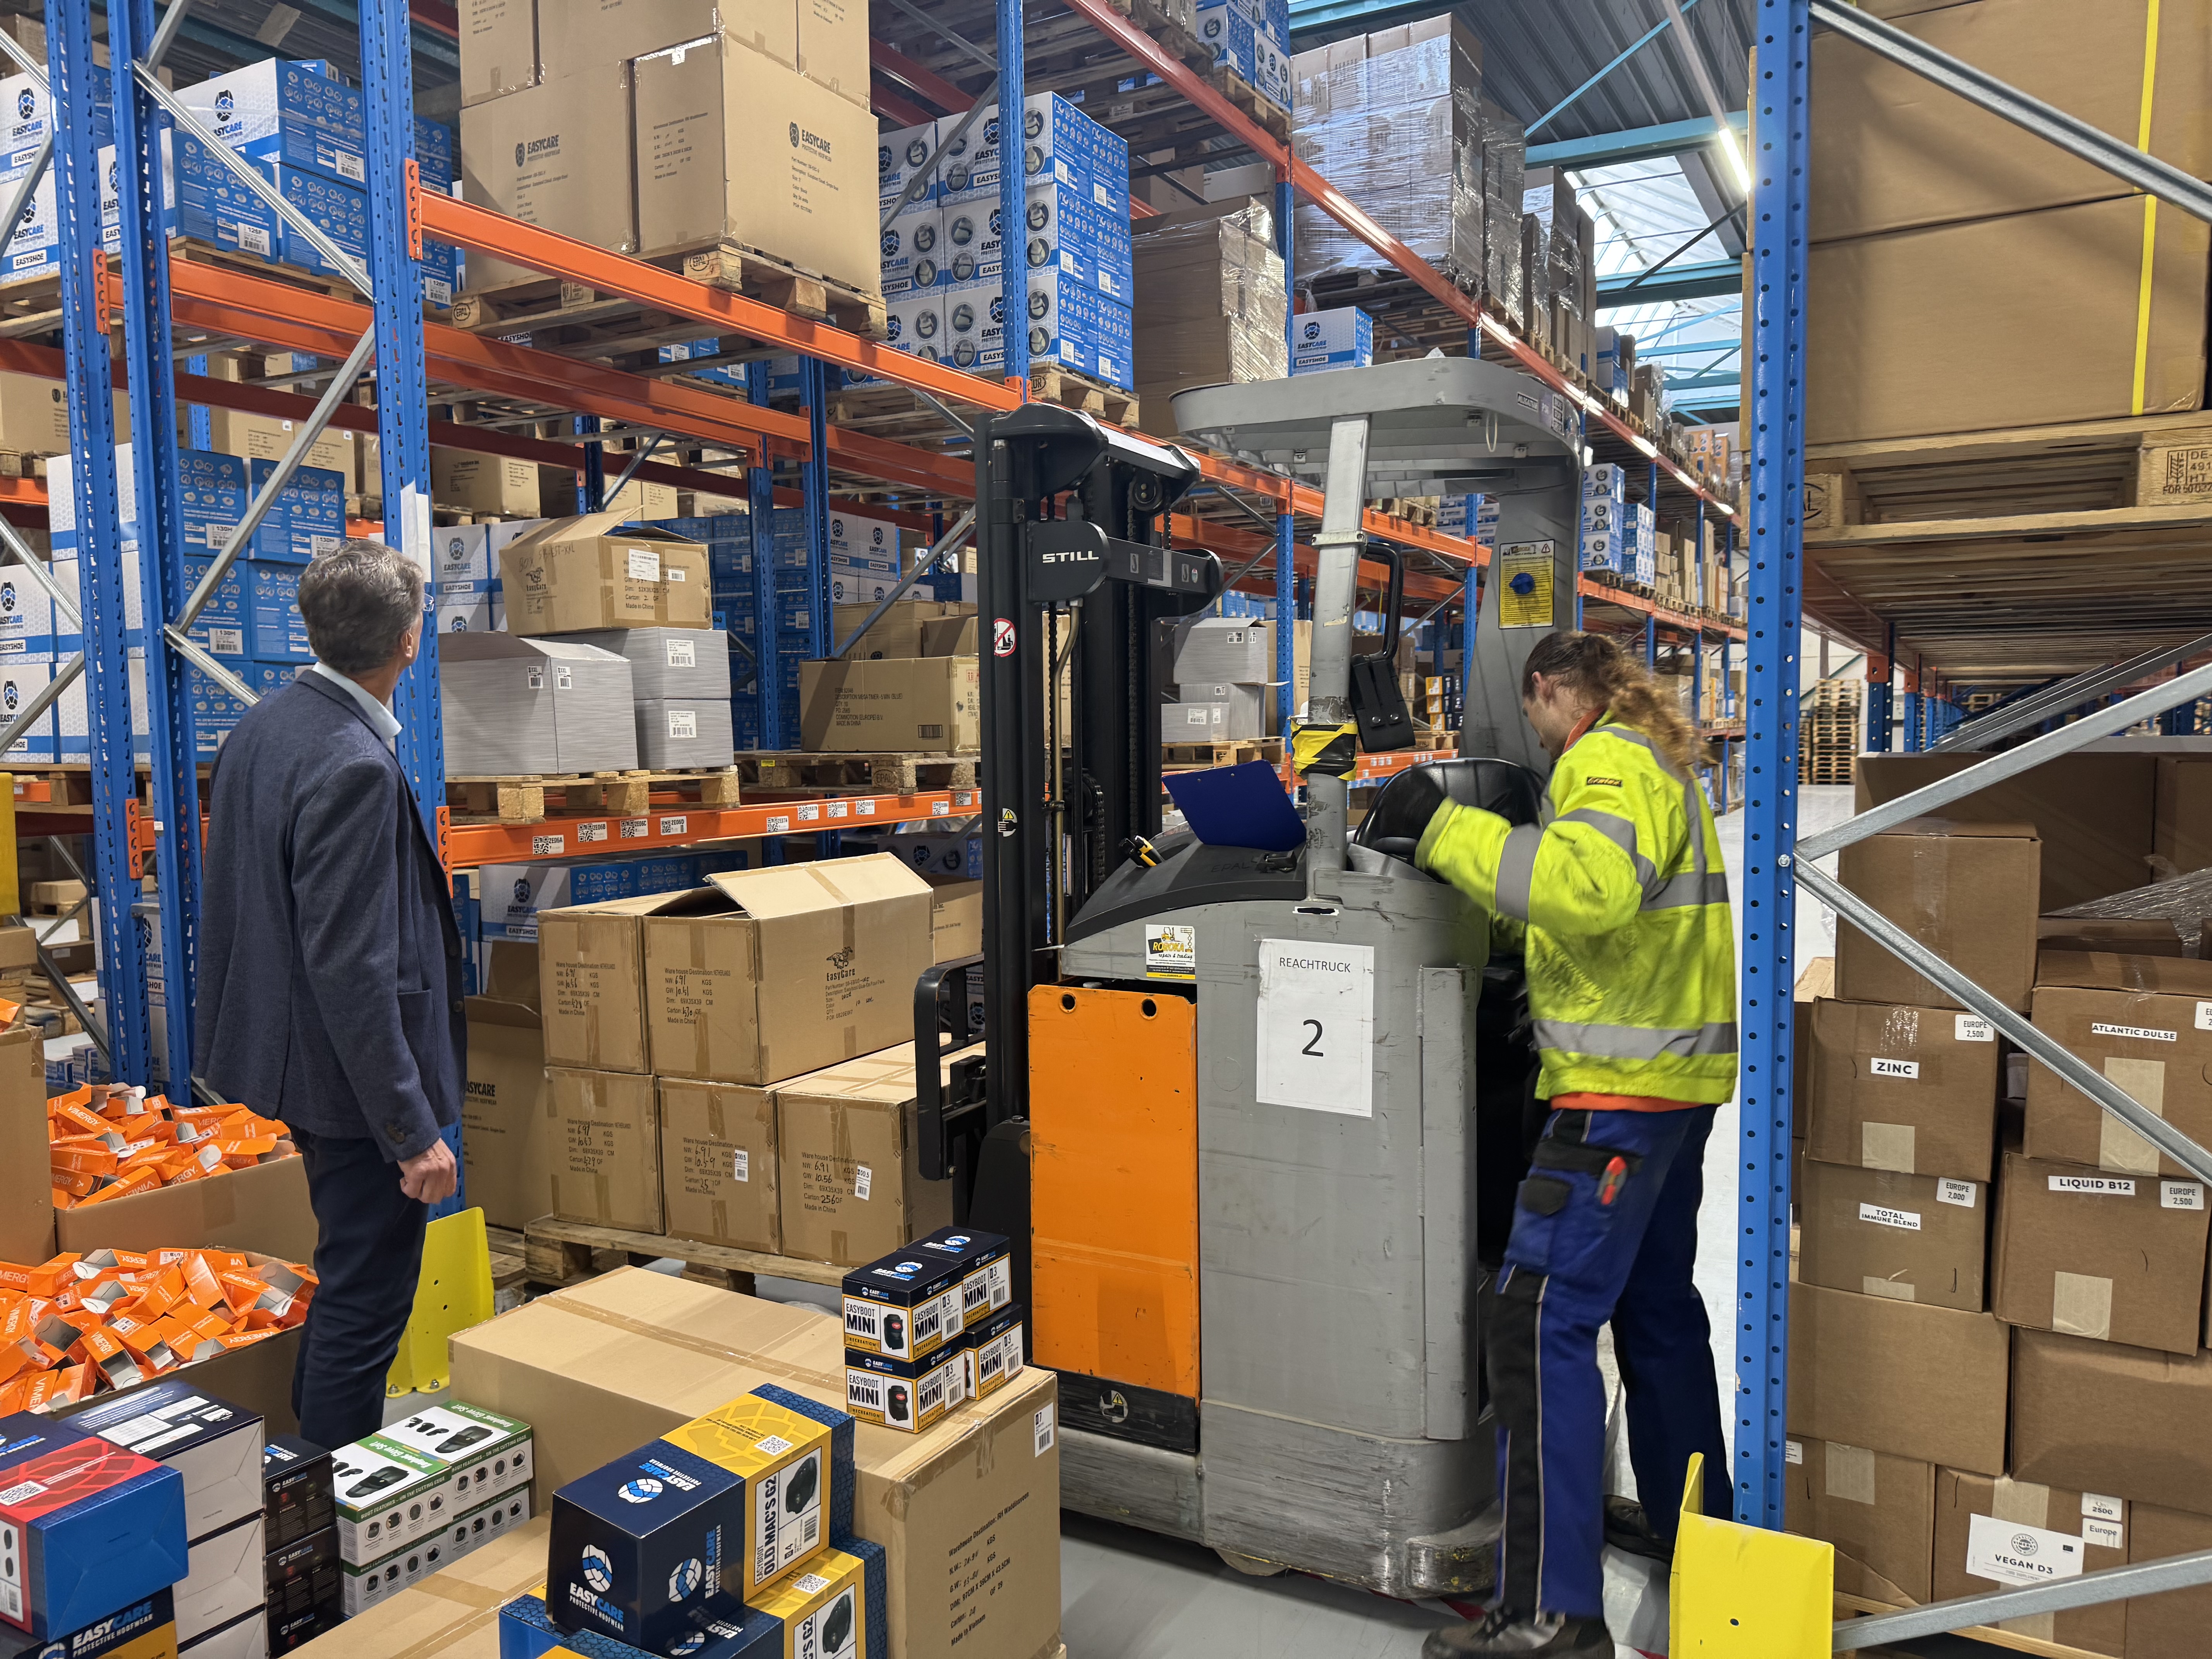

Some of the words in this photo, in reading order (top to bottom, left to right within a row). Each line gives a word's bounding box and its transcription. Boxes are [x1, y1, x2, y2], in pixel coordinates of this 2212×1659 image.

[12, 120, 43, 136] EASYCARE
[527, 135, 559, 155] EASYCARE
[802, 129, 830, 154] EASYCARE
[975, 148, 999, 160] EASYC
[14, 225, 44, 239] EASYCARE
[981, 240, 1001, 250] EASY
[16, 254, 44, 266] EASYSHOE
[1298, 340, 1326, 349] EASYCARE
[2190, 473, 2207, 483] HT
[1042, 550, 1099, 563] STILL
[444, 563, 471, 571] EASYCARE
[1211, 864, 1250, 872] EPAL
[1153, 942, 1184, 952] ROROKA
[1279, 957, 1351, 973] REACHTRUCK
[675, 975, 685, 985] 6.91
[827, 969, 855, 981] EasyCare
[1964, 1021, 1987, 1029] EUROPE
[1302, 1019, 1323, 1057] 2
[1967, 1030, 1984, 1038] 2,500
[2093, 1025, 2140, 1036] ATLANTIC
[2143, 1030, 2175, 1039] DULSE
[1877, 1062, 1912, 1074] ZINC
[815, 1162, 829, 1173] 6.91
[815, 1173, 832, 1184] 10.56
[2059, 1178, 2104, 1189] LIQUID
[2109, 1180, 2131, 1190] B12
[1946, 1182, 1970, 1192] EUROPE
[2170, 1187, 2196, 1196] EUROPE
[820, 1195, 835, 1204] 256
[1948, 1192, 1965, 1201] 2,000
[2173, 1197, 2192, 1206] 2,500
[823, 1205, 836, 1213] China
[1876, 1209, 1904, 1220] TOTAL
[1862, 1213, 1892, 1224] IMMUNE
[1894, 1219, 1918, 1227] BLEND
[874, 1268, 915, 1279] EASYCARE
[964, 1273, 986, 1292] EASYBOOT
[869, 1289, 889, 1297] EASYCARE
[964, 1287, 987, 1309] MINI
[946, 1295, 950, 1305] 3
[847, 1304, 875, 1316] EASYBOOT
[915, 1302, 938, 1323] EASYBOOT
[847, 1316, 875, 1334] MINI
[915, 1316, 939, 1340] MINI
[849, 1337, 876, 1347] RECREATION
[917, 1337, 939, 1352] RECREATION
[981, 1342, 1001, 1362] EASYBOOT
[950, 1364, 953, 1374] 3
[981, 1352, 1001, 1379] MINI
[849, 1375, 878, 1389] EASYBOOT
[919, 1372, 941, 1394] EASYBOOT
[849, 1385, 879, 1406] MINI
[920, 1382, 942, 1412] MINI
[852, 1409, 880, 1418] RECREATION
[369, 1441, 384, 1451] Soft
[649, 1458, 675, 1474] HOOFWEAR
[639, 1462, 696, 1491] EASYCARE
[675, 1471, 701, 1486] PROTECTIVE
[765, 1475, 776, 1498] G2
[2092, 1507, 2112, 1515] 2500
[765, 1498, 776, 1547] MAC'S
[2090, 1525, 2117, 1536] Europe
[949, 1536, 972, 1557] Warehouse
[973, 1517, 997, 1539] Destination:
[987, 1534, 995, 1546] KGS
[705, 1528, 716, 1599] EASYCARE
[756, 1545, 764, 1582] EASYBOOT
[764, 1546, 775, 1575] OLD
[988, 1552, 996, 1563] KGS
[1995, 1554, 2033, 1570] VEGAN
[2038, 1565, 2053, 1575] D3
[990, 1586, 996, 1596] OF
[570, 1582, 624, 1623] EASYCARE
[950, 1599, 960, 1611] DIM:
[570, 1595, 598, 1616] PROTECTIVE
[599, 1609, 624, 1632] HOOFWEAR
[73, 1601, 152, 1648] EASYCARE
[803, 1617, 813, 1640] G2
[73, 1633, 115, 1658] PROTECTIVE
[117, 1614, 153, 1635] HOOFWEAR
[951, 1633, 963, 1646] Made
